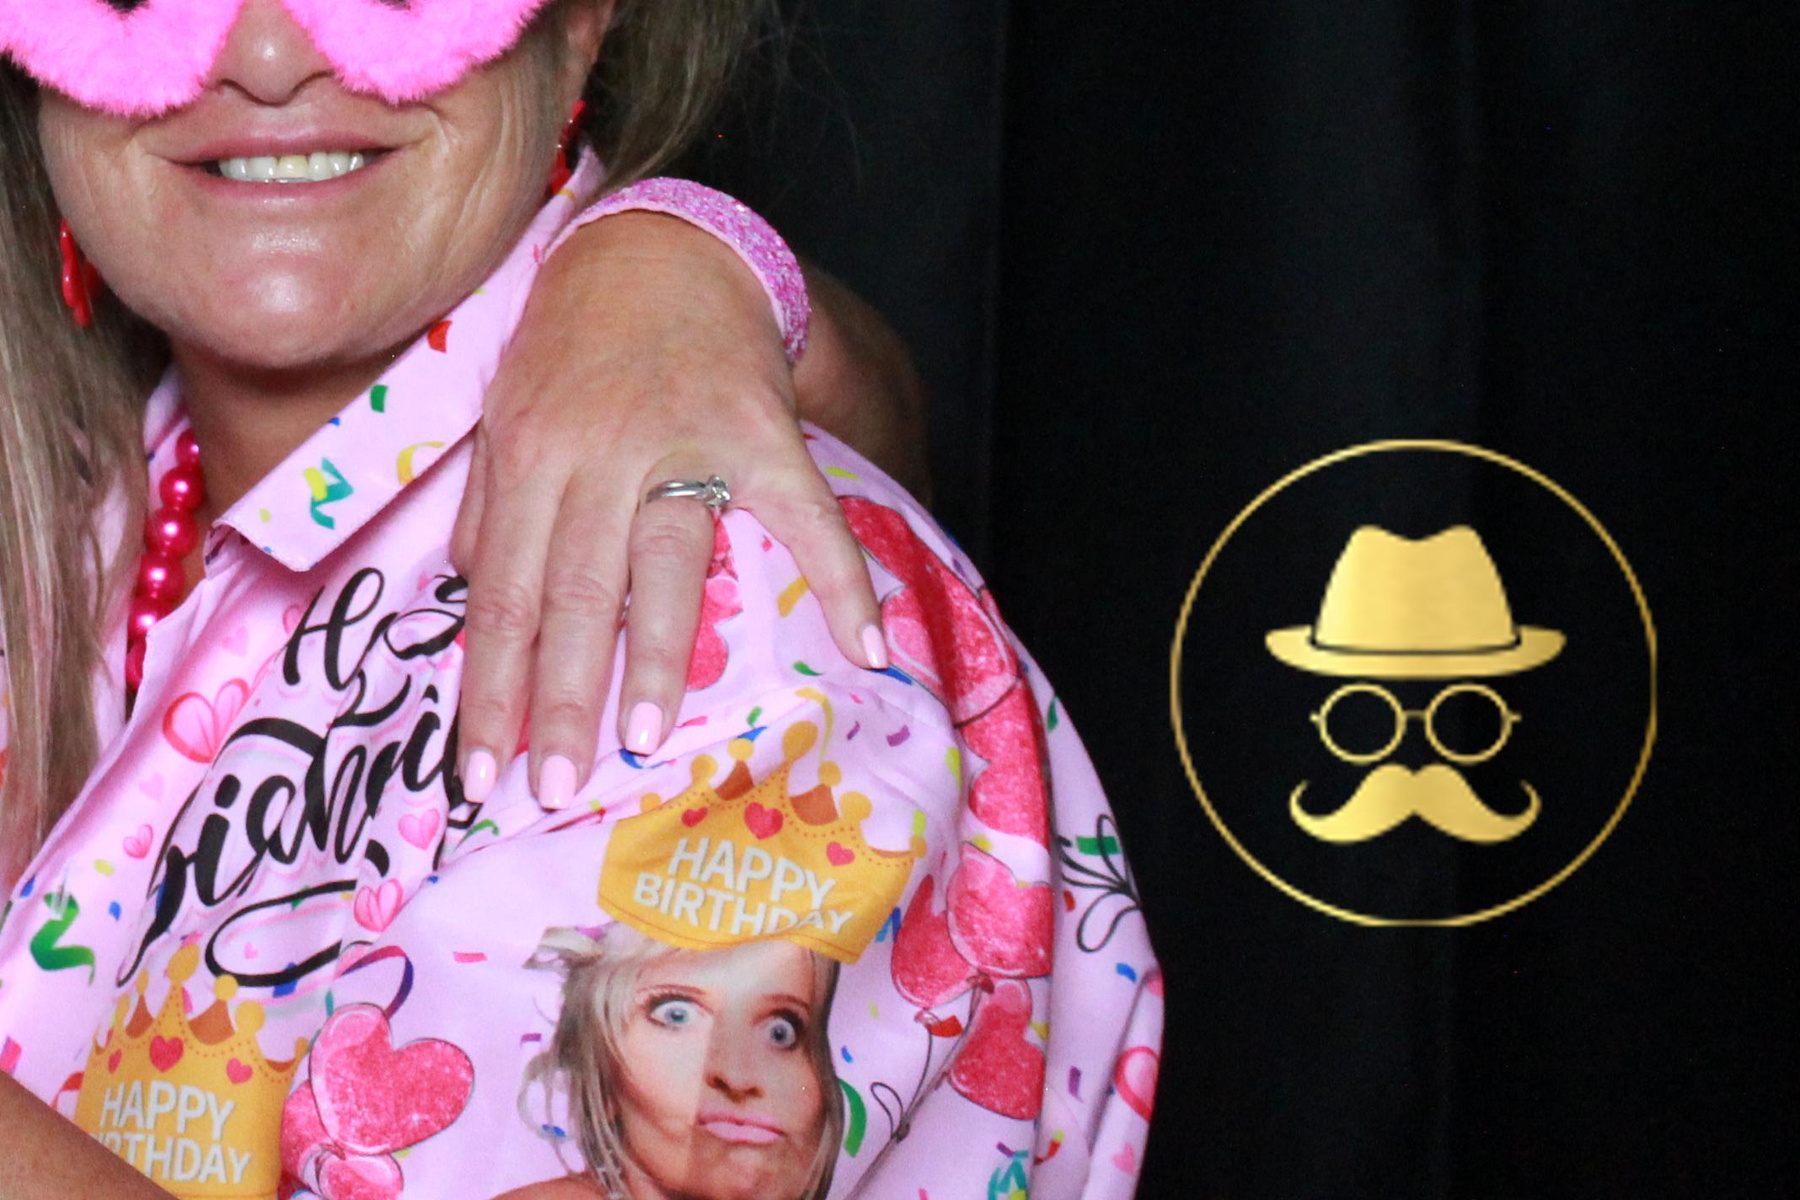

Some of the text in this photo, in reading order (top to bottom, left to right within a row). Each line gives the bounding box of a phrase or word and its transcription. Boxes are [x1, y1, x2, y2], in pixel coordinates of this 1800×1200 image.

[634, 871, 854, 937] BIRTHDAY
[667, 836, 837, 910] HAPPY
[101, 1079, 236, 1141] HAPPY
